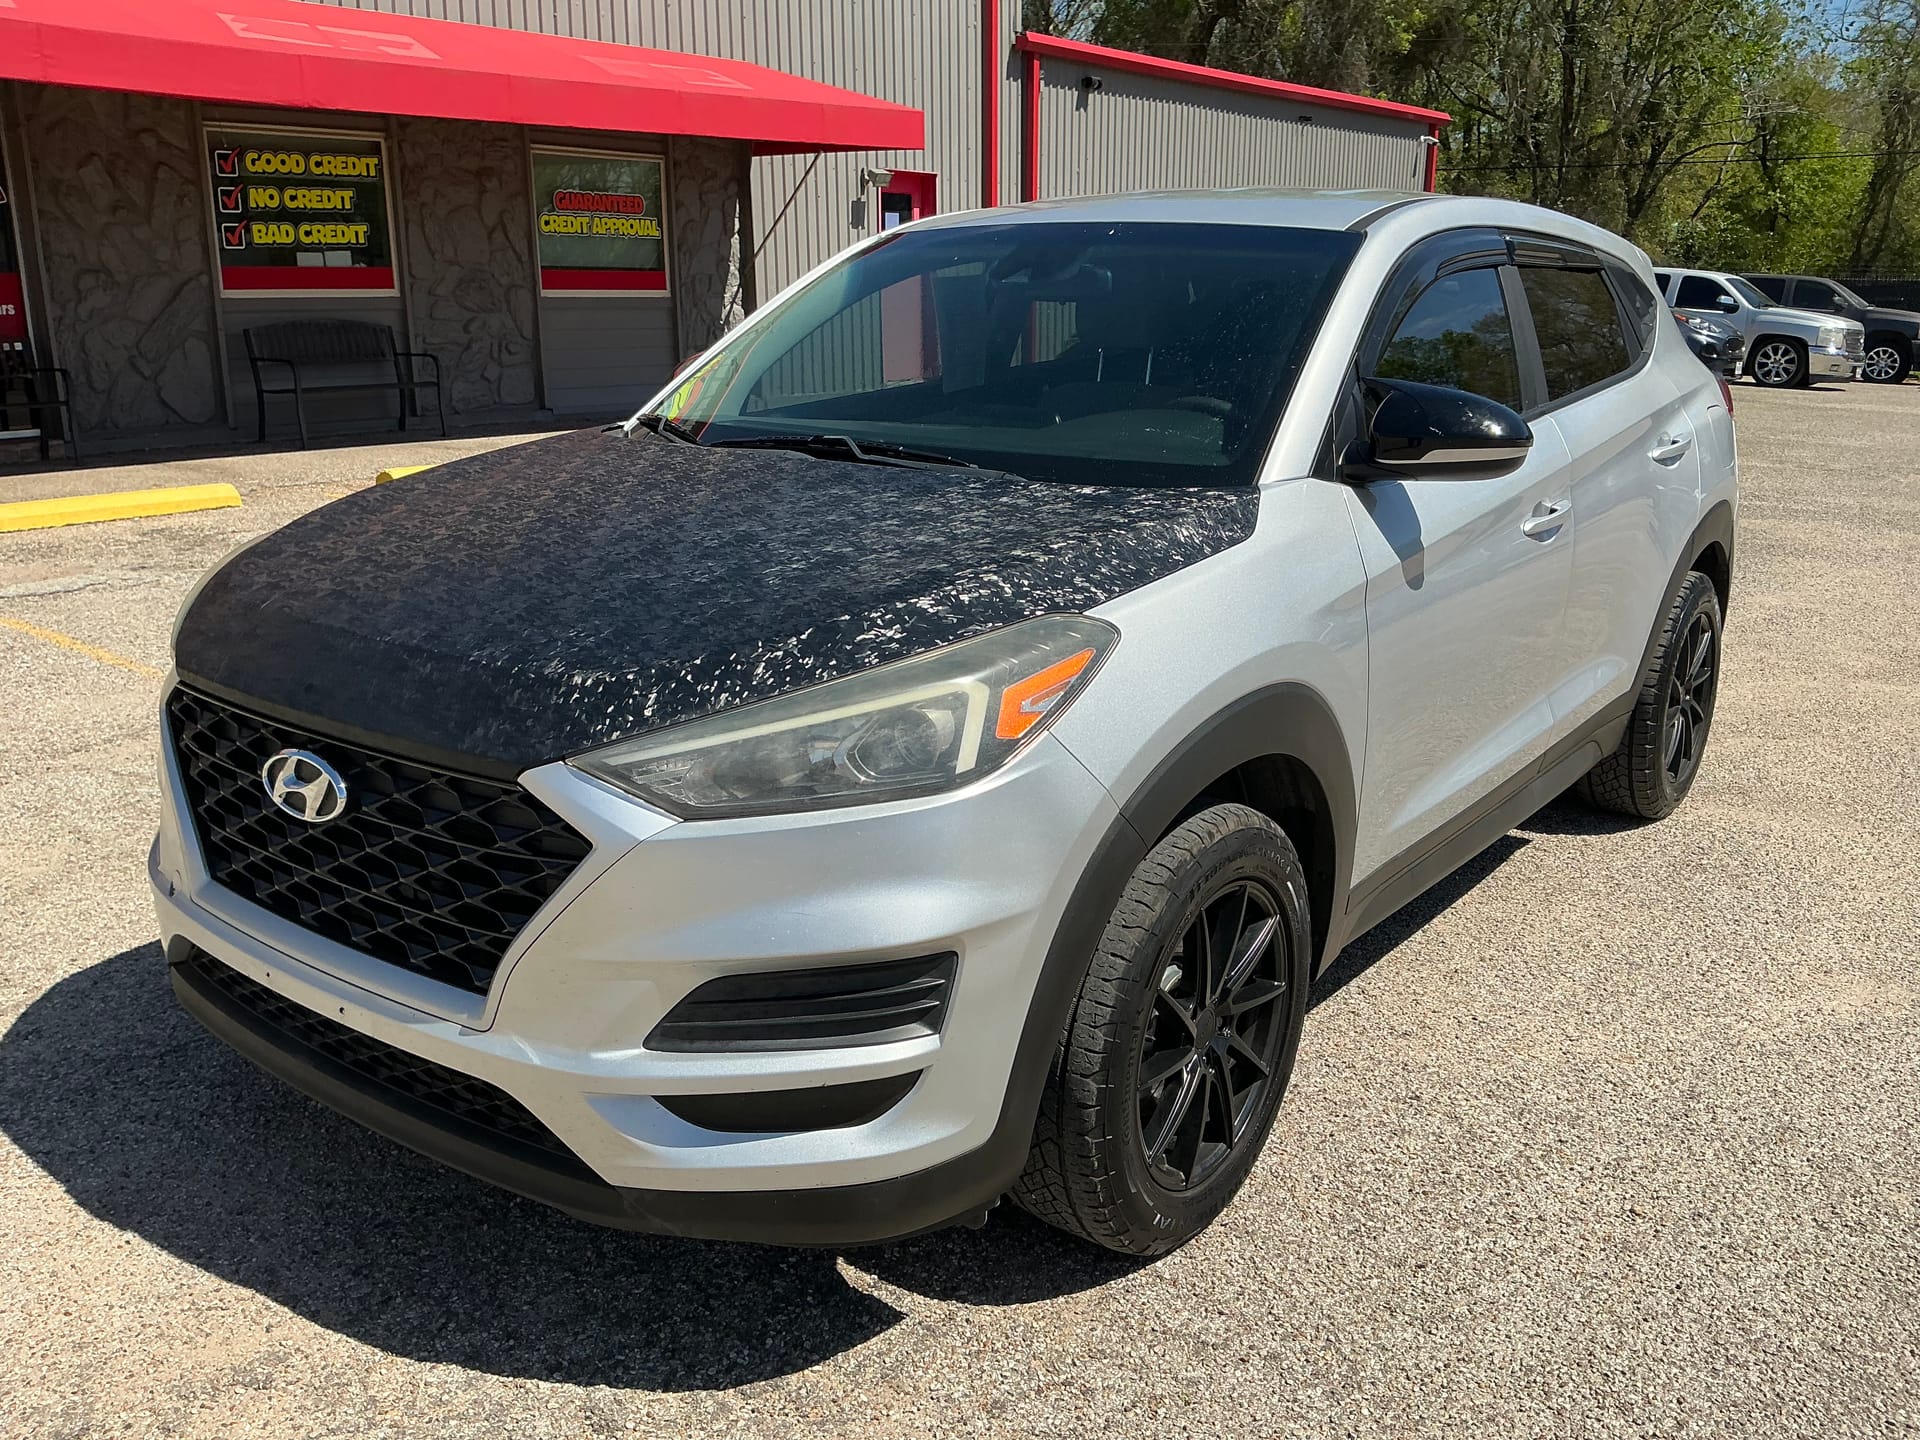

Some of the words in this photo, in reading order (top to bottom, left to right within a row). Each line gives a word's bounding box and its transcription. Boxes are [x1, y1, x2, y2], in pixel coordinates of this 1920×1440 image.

[245, 152, 305, 175] GOOD
[309, 154, 379, 177] CREDIT
[249, 187, 280, 208] NO
[284, 188, 354, 209] CREDIT
[555, 191, 644, 214] GUARANTEED
[252, 223, 295, 244] BAD
[299, 224, 367, 245] CREDIT
[540, 214, 590, 235] CREDIT
[592, 216, 661, 238] APPROVAL
